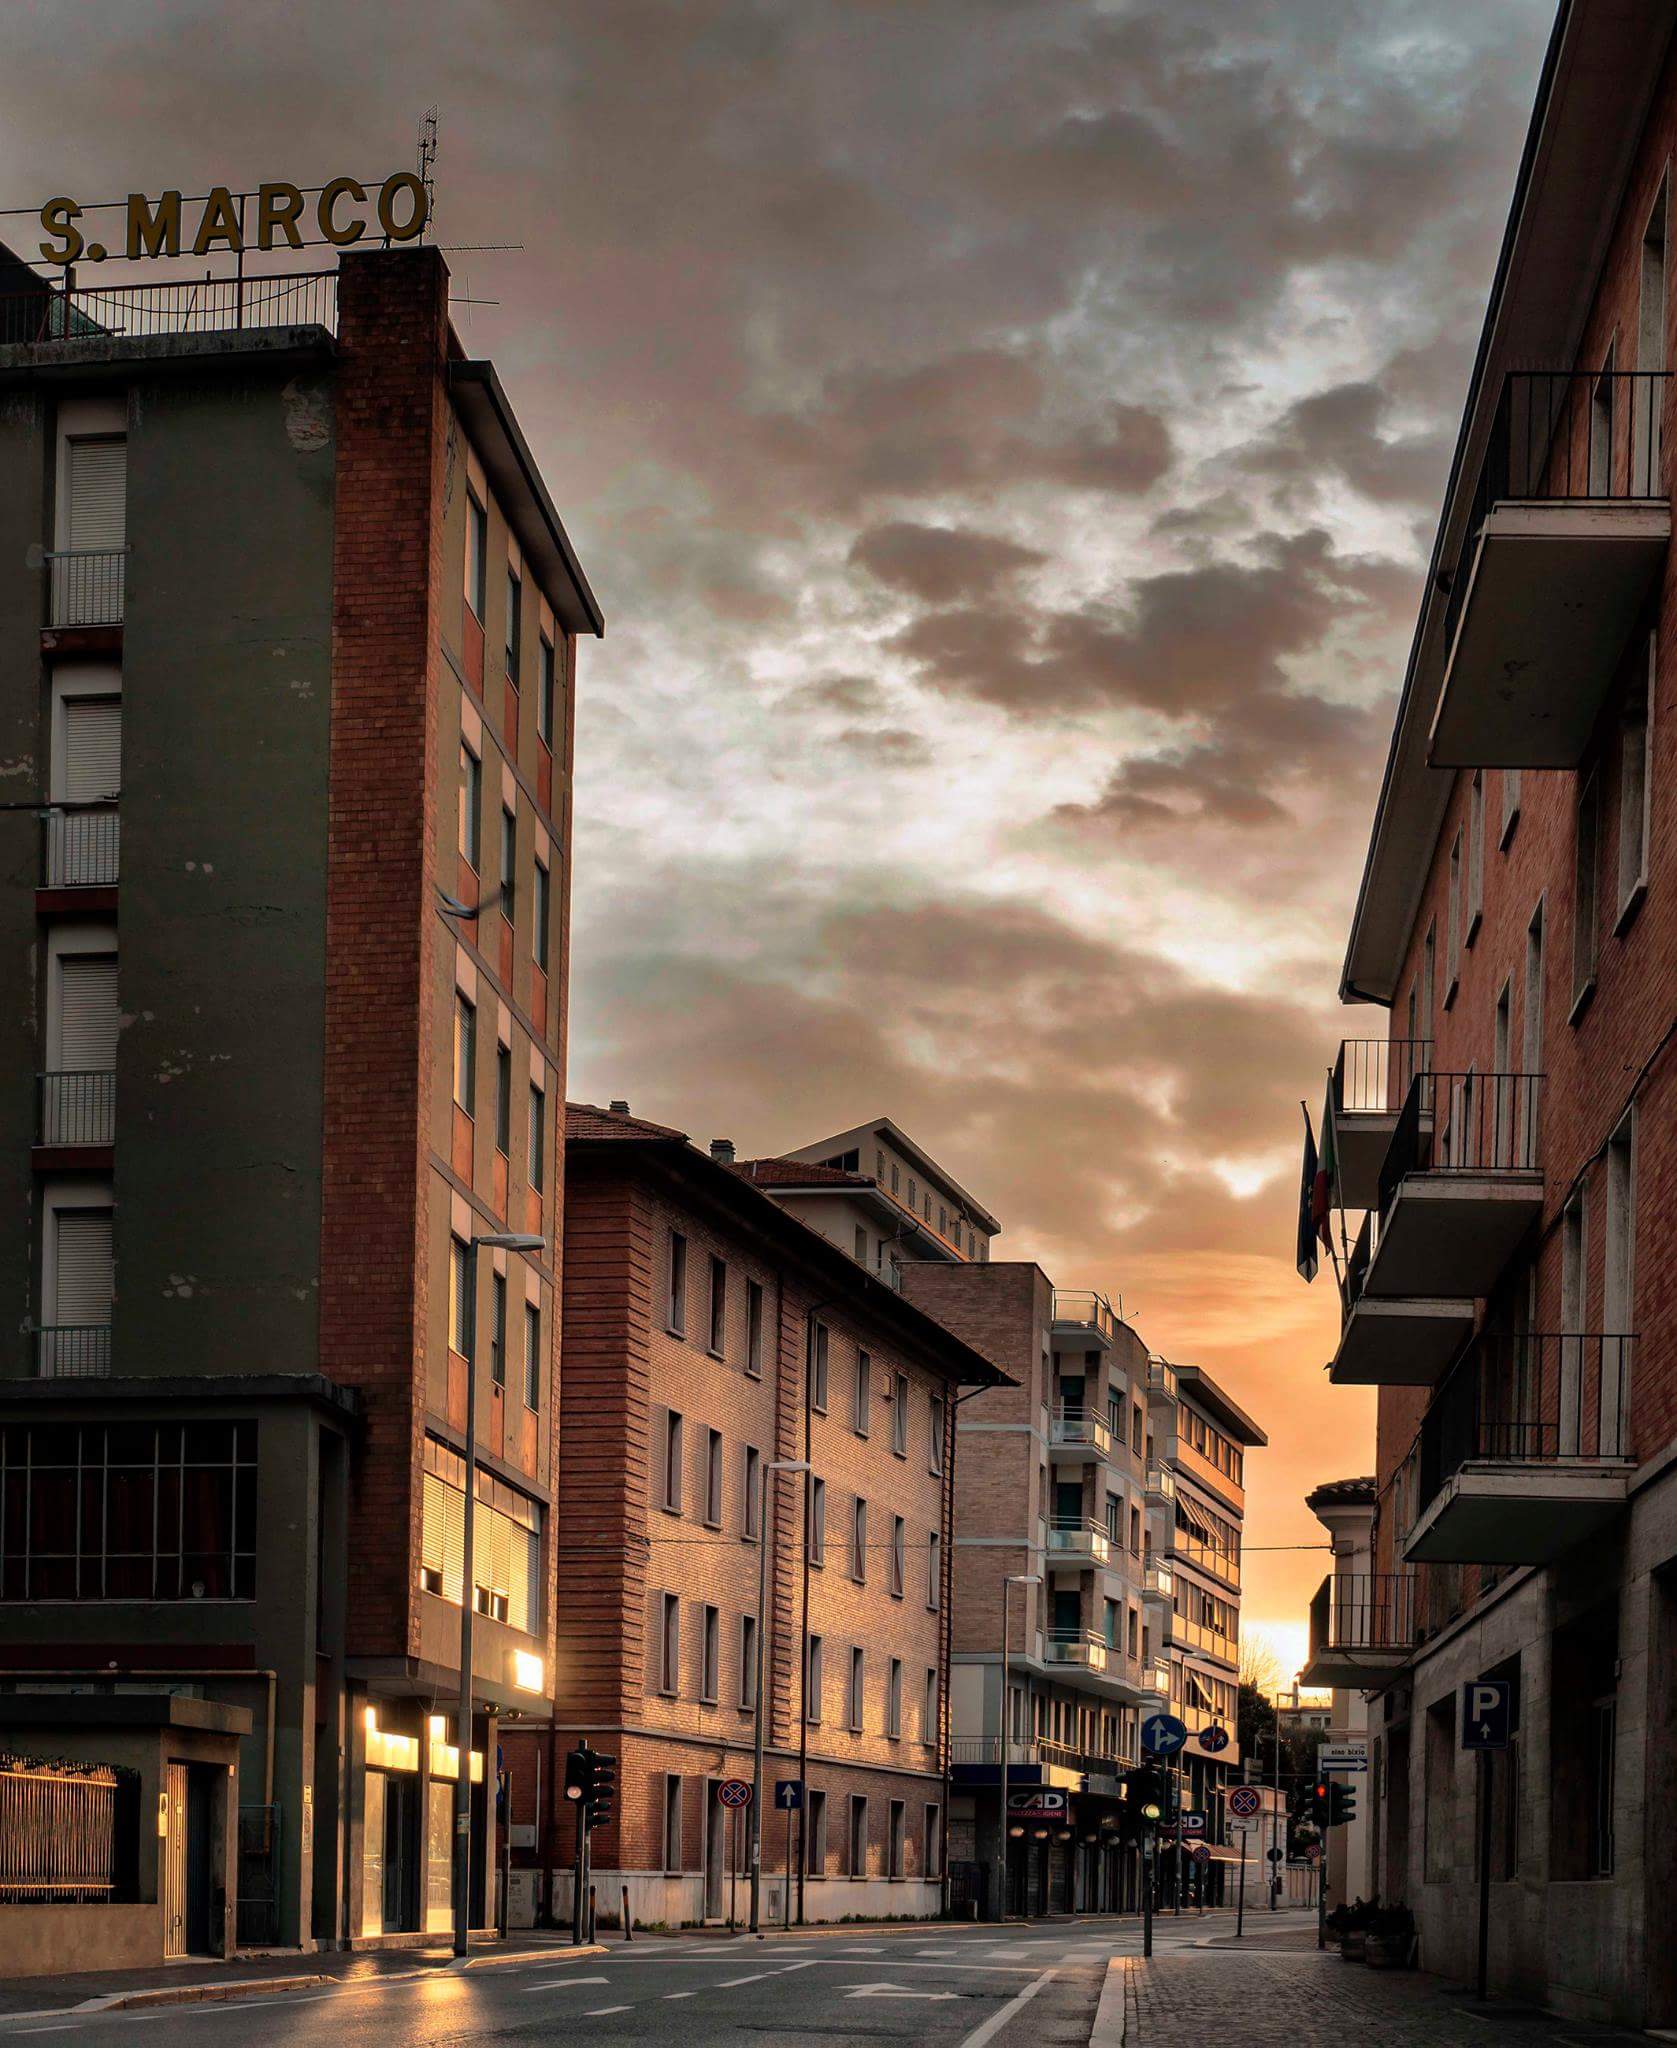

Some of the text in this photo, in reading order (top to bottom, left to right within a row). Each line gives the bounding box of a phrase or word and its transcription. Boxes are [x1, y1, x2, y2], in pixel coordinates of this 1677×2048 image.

[40, 172, 427, 265] S. MARCO
[1472, 1686, 1501, 1722] P
[1008, 1793, 1064, 1809] CAD
